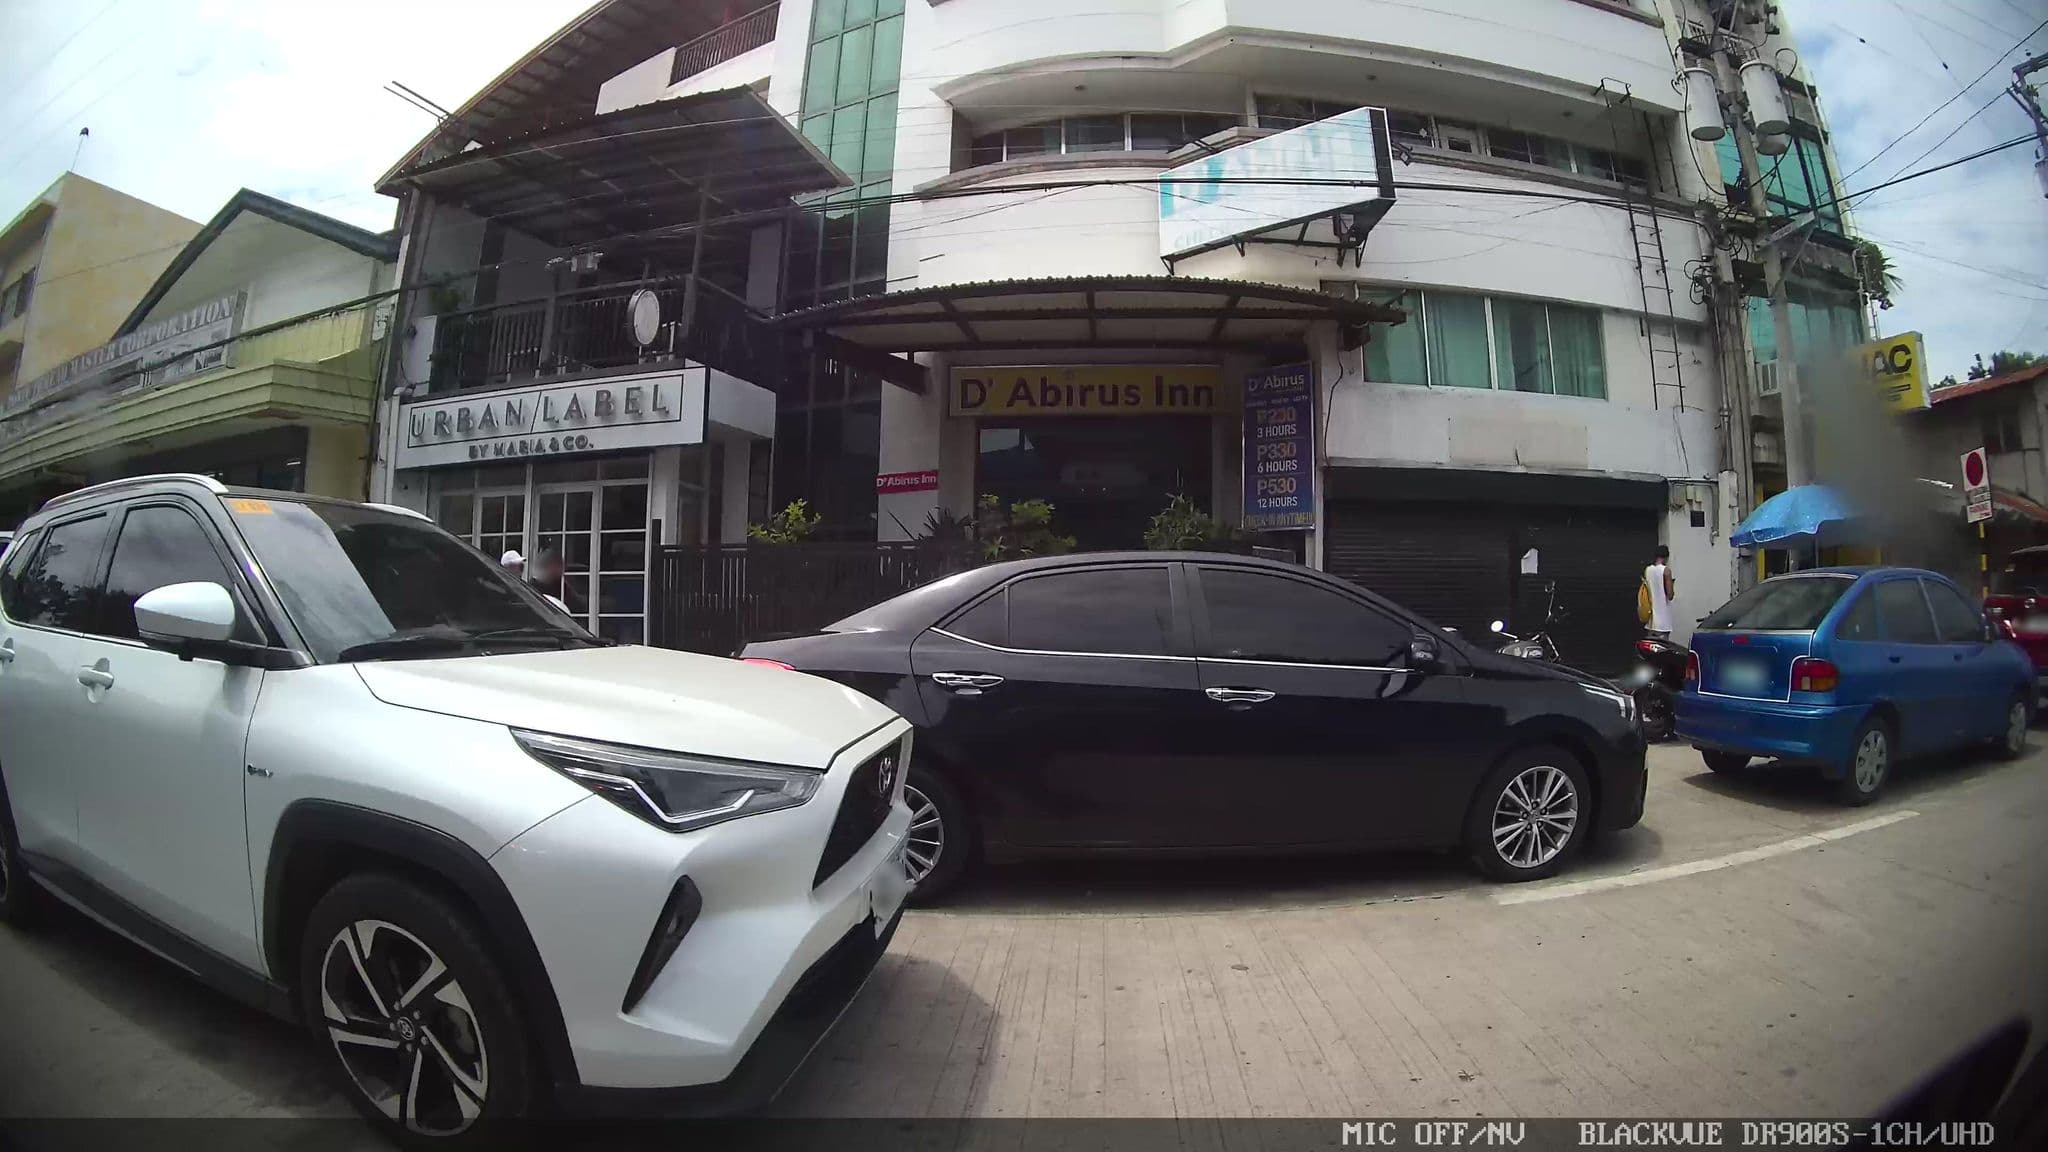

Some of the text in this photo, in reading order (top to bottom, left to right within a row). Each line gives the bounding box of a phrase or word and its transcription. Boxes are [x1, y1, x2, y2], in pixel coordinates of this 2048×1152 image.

[1264, 374, 1305, 389] Abirus
[1006, 375, 1142, 407] Abirus
[1154, 375, 1214, 406] Inn
[410, 383, 670, 438] URBAN LABEL
[1257, 424, 1297, 438] 3 HOURS
[468, 443, 489, 459] BY
[1257, 460, 1298, 473] 6 HOURS
[921, 474, 937, 484] Inn
[1258, 497, 1298, 509] 12 HOURS
